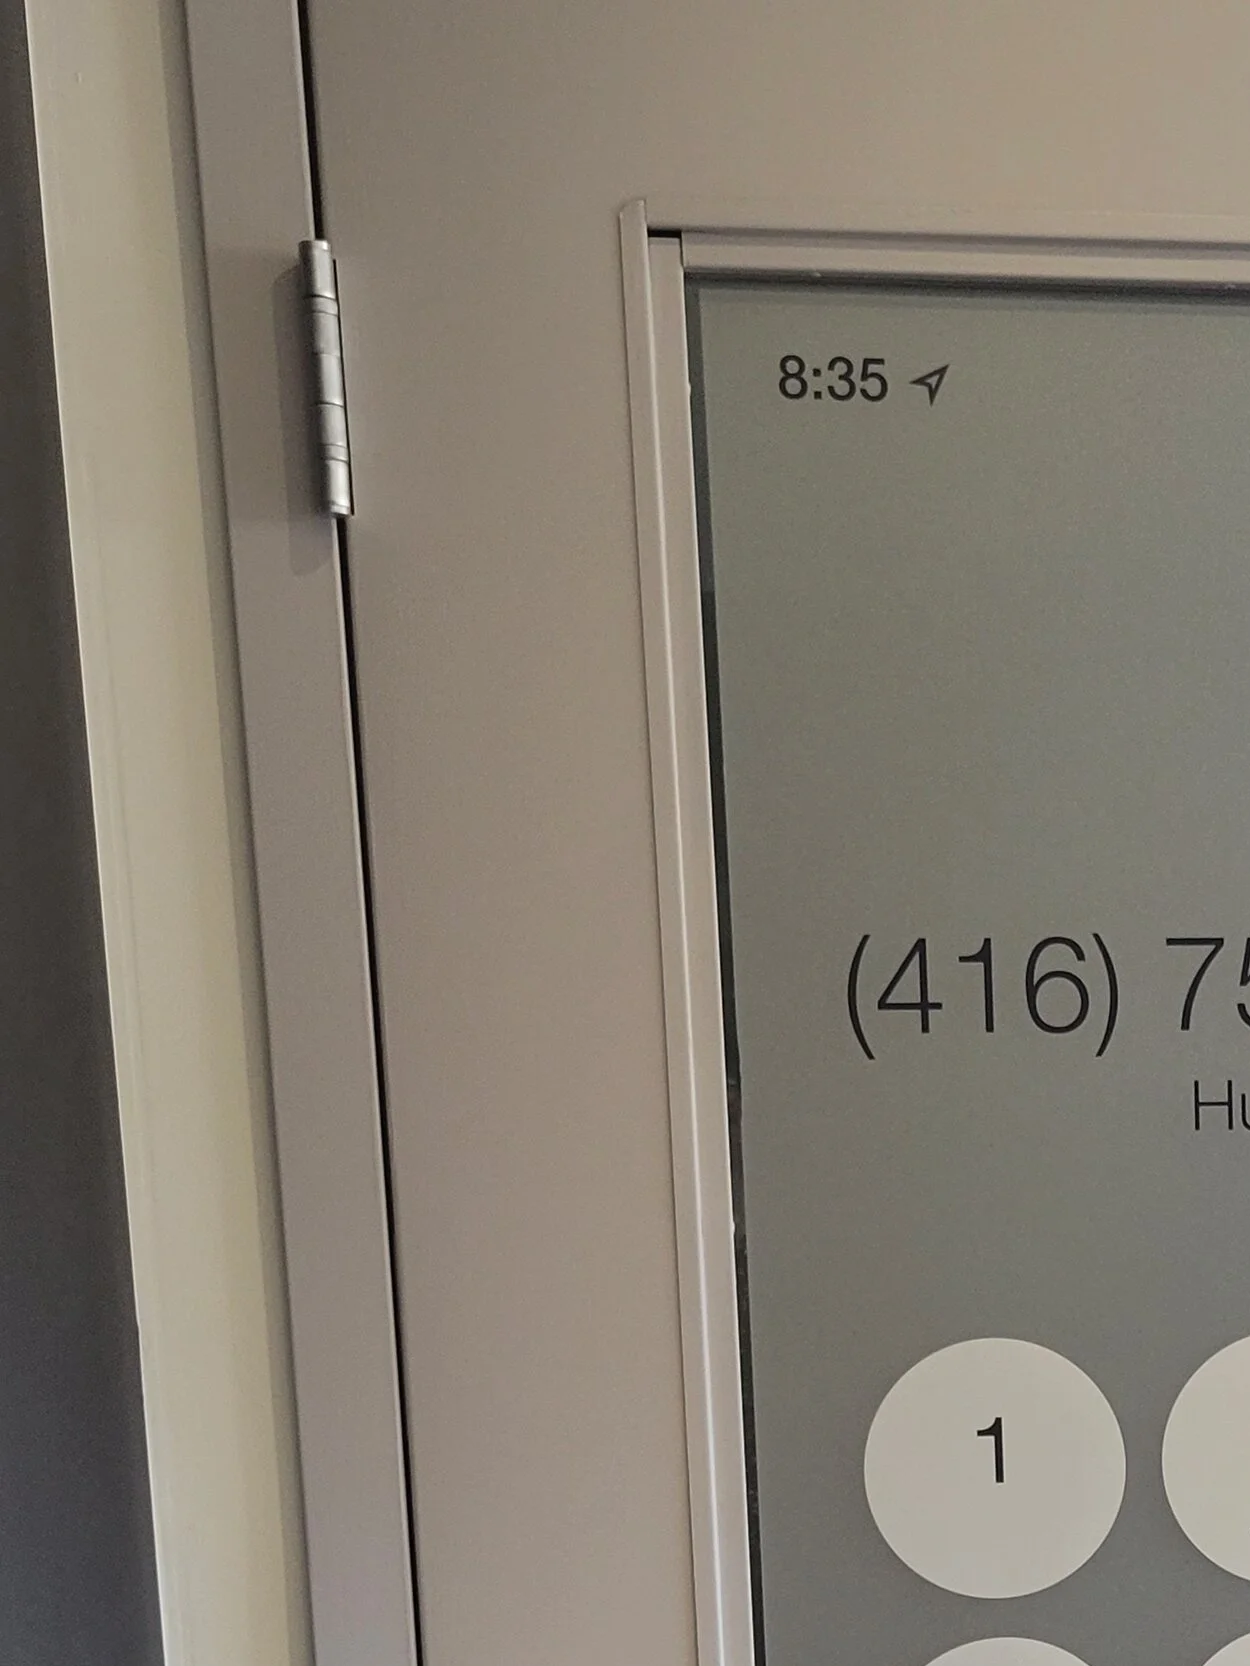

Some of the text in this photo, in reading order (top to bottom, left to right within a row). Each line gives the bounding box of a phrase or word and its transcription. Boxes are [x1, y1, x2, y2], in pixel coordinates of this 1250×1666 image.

[778, 354, 889, 403] 8:35
[847, 932, 1119, 1061] (416)
[976, 1416, 1005, 1484] 1
